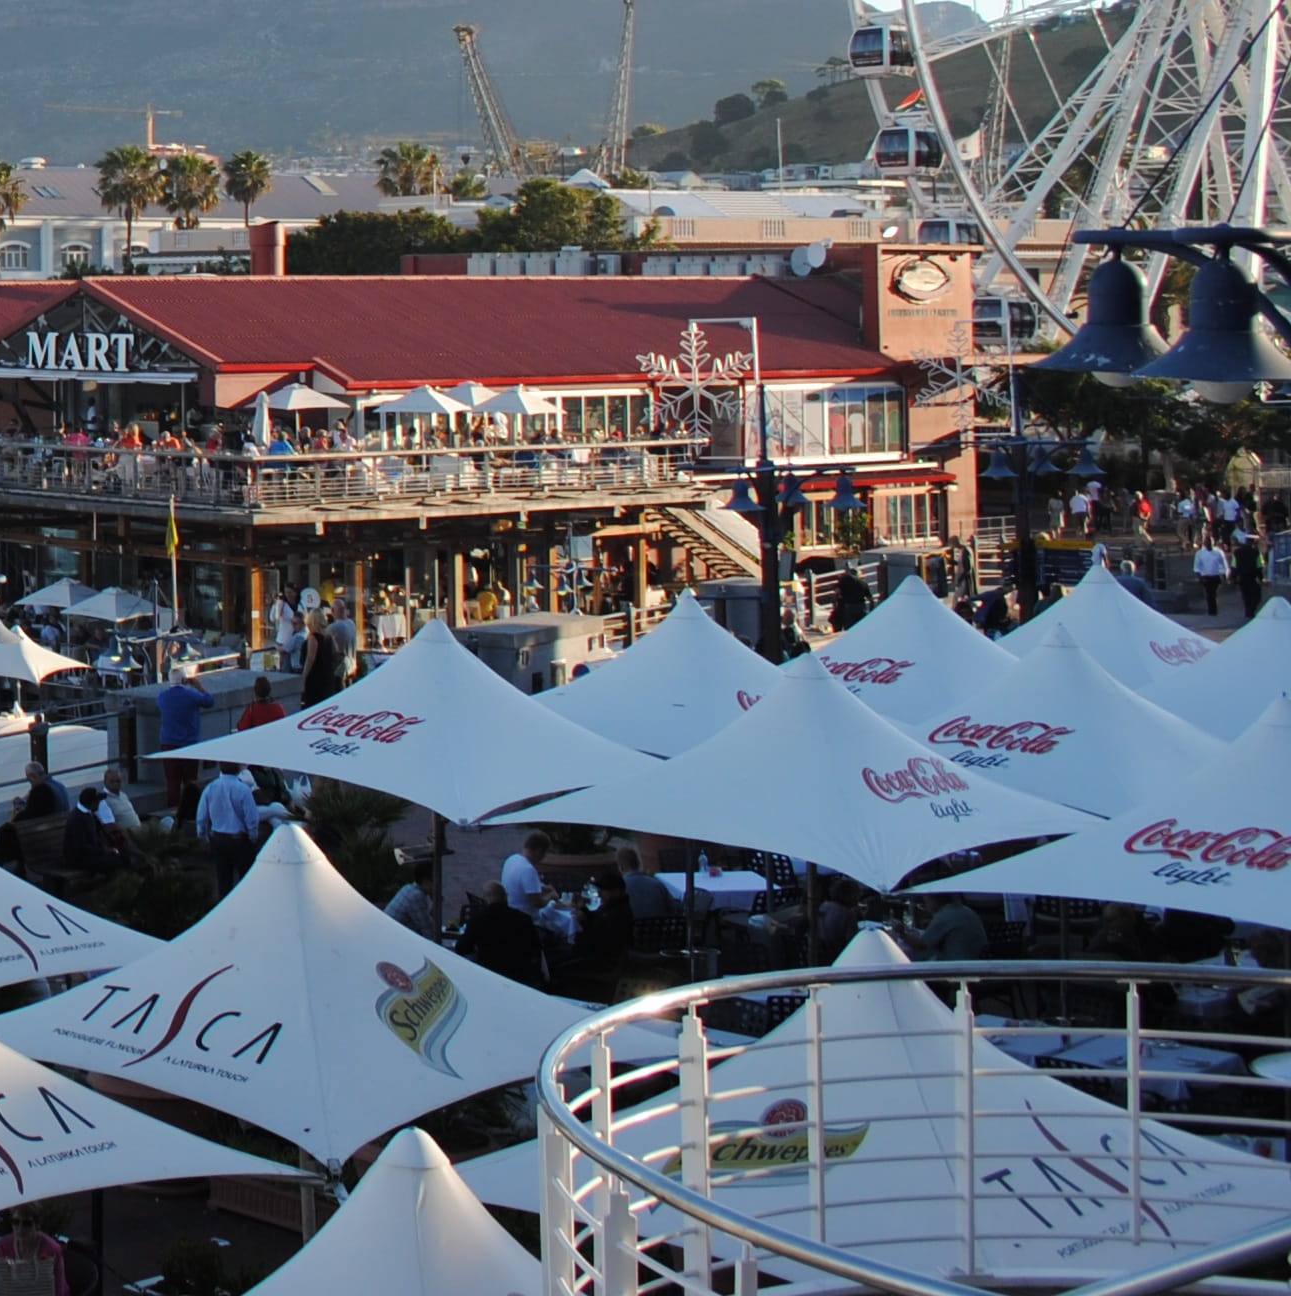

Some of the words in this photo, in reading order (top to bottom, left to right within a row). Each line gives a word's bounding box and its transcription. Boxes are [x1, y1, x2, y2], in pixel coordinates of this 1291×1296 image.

[26, 332, 134, 371] MART
[297, 704, 425, 744] Coca-Cola
[928, 715, 1075, 754] Coca-Cola
[309, 737, 360, 756] light
[950, 750, 1009, 768] light
[862, 757, 969, 803] Coca-Cola
[930, 798, 973, 822] light
[1124, 818, 1291, 871] Coca-Cola
[1151, 862, 1231, 886] light
[82, 964, 283, 1065] TASCA
